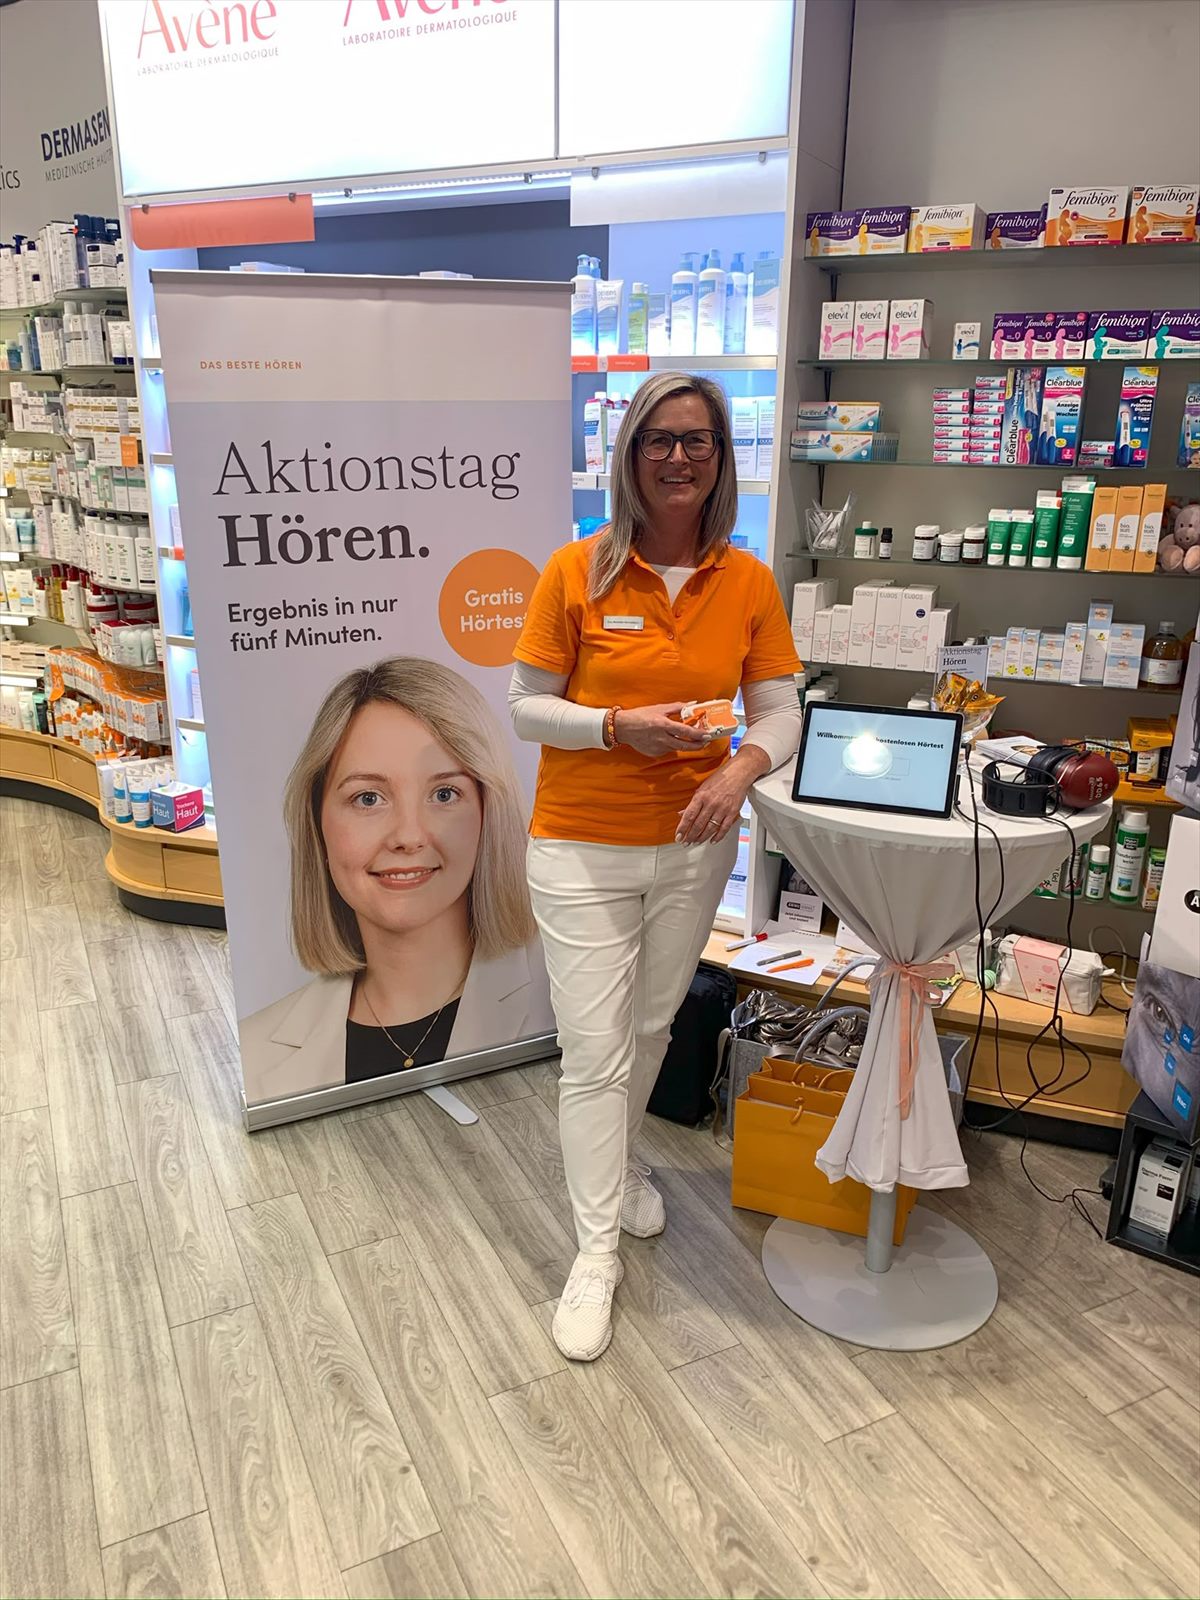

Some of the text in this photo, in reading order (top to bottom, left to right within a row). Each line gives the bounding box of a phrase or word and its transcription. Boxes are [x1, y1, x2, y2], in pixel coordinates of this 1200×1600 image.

[343, 27, 411, 46] LABORATOIRE
[416, 10, 518, 35] DERMATOLOGIQUE
[137, 47, 280, 77] LABORATOIRE DERMATOLOGIQUE
[45, 156, 95, 181] MEDIZINISCHE
[1059, 190, 1118, 210] femibion
[1136, 186, 1195, 206] femibion
[856, 209, 904, 227] femibion
[920, 207, 963, 223] femibion
[1108, 207, 1116, 218] 2
[1186, 204, 1194, 215] 2
[808, 213, 855, 231] femibion
[988, 213, 1039, 231] femibion
[1090, 312, 1147, 331] femibion
[1137, 330, 1144, 338] 3
[200, 358, 302, 370] DAS BESTE HÖREN
[1046, 378, 1082, 387] Clearblue
[1123, 379, 1156, 387] Clearblue
[1006, 419, 1019, 464] Clearblue
[212, 440, 521, 500] Aktionstag
[218, 513, 430, 567] Hören.
[464, 587, 524, 608] Gratis
[227, 596, 398, 628] Ergebnis in nur
[230, 624, 382, 652] fünf Minuten.
[943, 657, 967, 666] Hören
[917, 741, 944, 750] Hörtest
[153, 806, 170, 819] Haut
[176, 806, 198, 820] Haut
